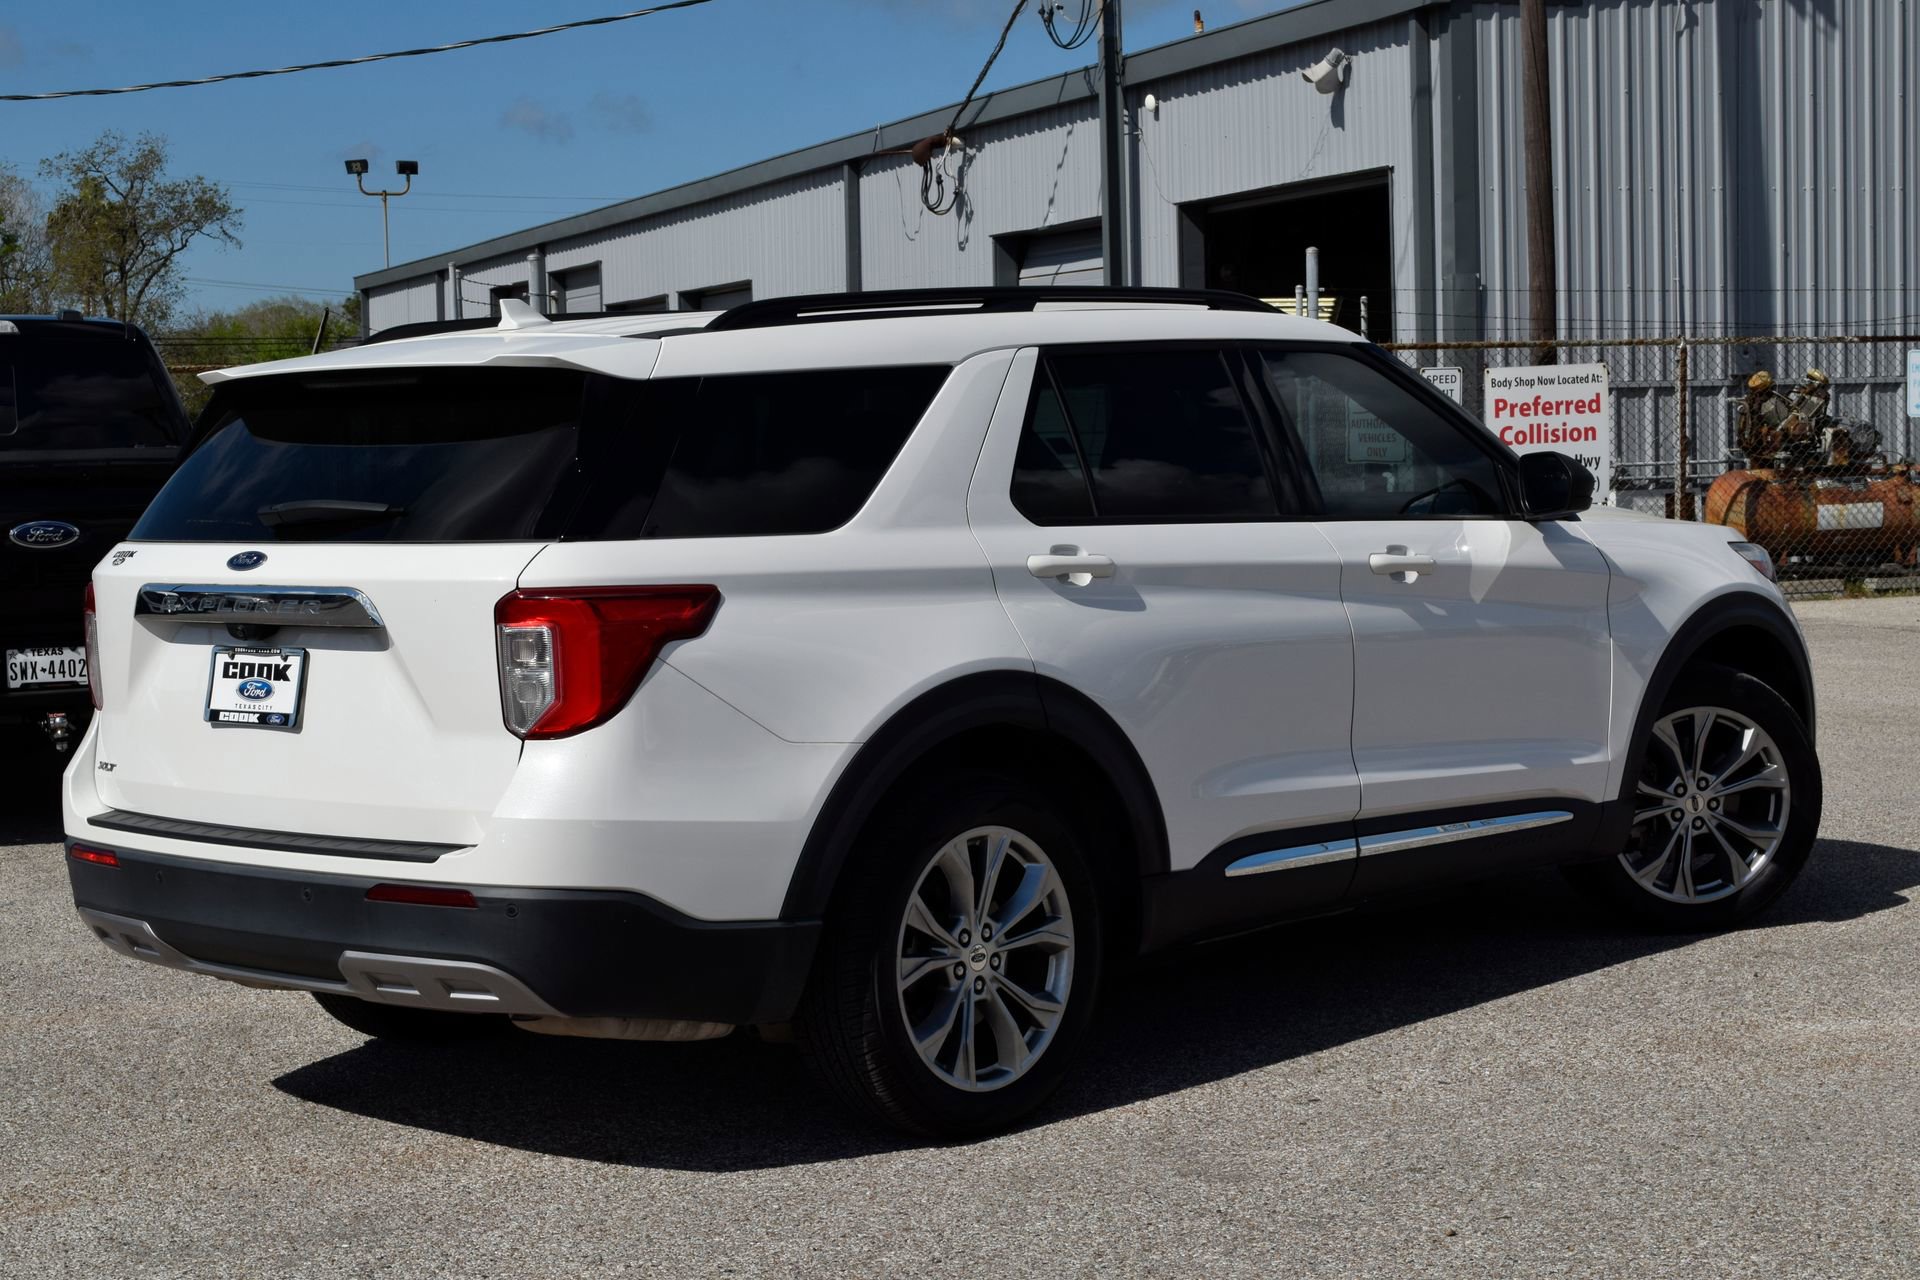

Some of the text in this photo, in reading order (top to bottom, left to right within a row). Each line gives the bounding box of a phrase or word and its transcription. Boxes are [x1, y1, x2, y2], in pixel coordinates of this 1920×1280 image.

[1427, 374, 1457, 384] SPEED
[1491, 373, 1603, 390] Body Shop Now Located At:
[1494, 392, 1602, 419] Preferred
[1358, 432, 1397, 444] VEHICLES
[1500, 422, 1597, 446] Collision
[1366, 446, 1388, 457] ONLY
[1575, 454, 1601, 471] Hwy
[161, 594, 322, 616] EXPLORER
[31, 647, 64, 657] TEXAS
[9, 658, 87, 681] SWX 4402
[222, 661, 292, 682] COOK
[243, 681, 267, 698] Ford
[219, 711, 260, 723] COOK
